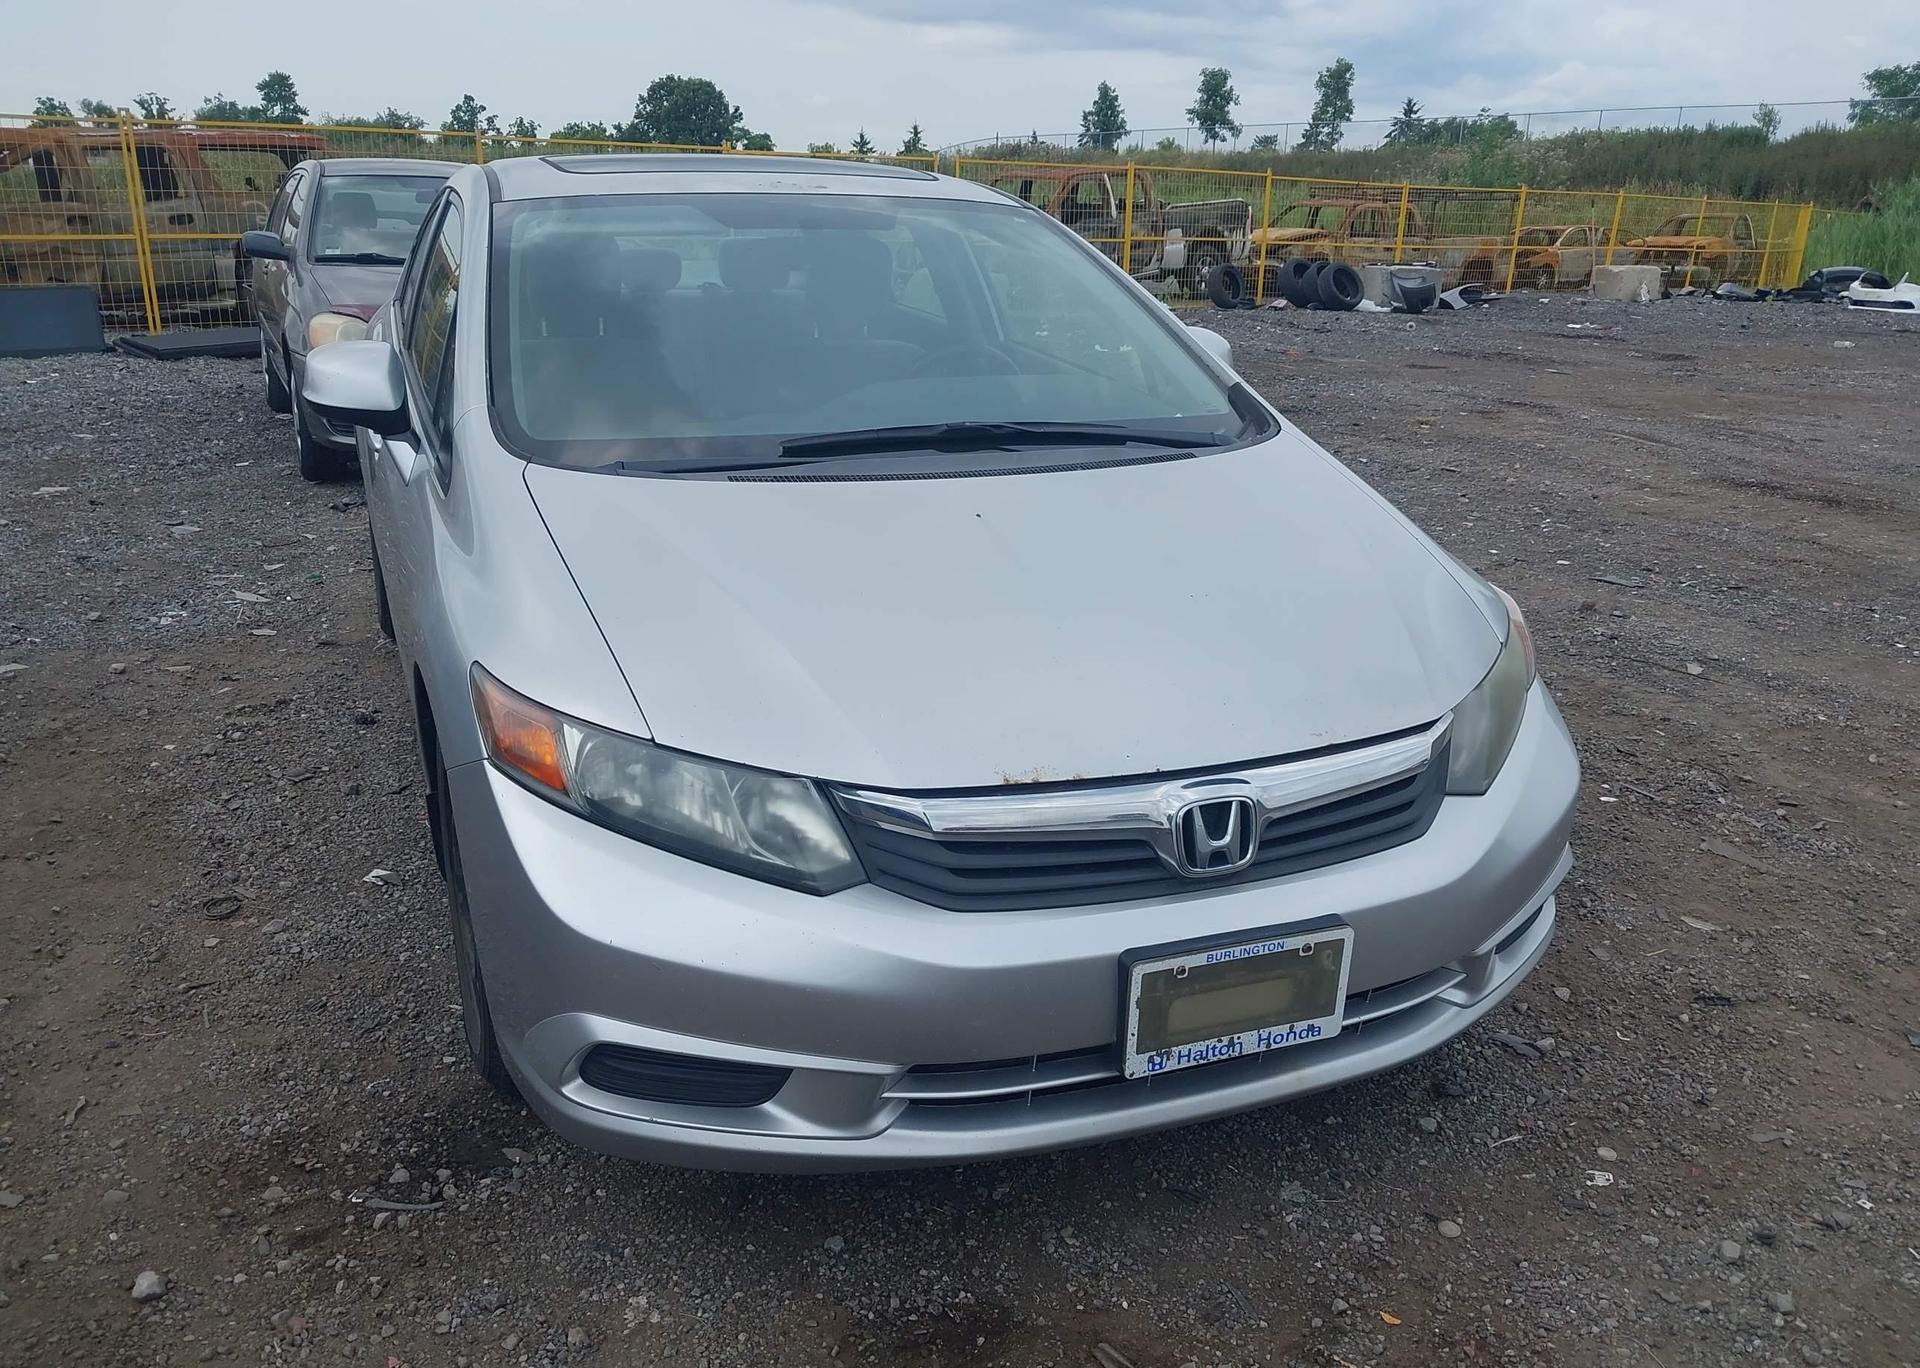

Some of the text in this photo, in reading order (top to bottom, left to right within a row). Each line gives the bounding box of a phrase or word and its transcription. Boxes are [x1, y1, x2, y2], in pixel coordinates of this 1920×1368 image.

[1206, 941, 1285, 963] BURLINGTON
[1177, 1040, 1243, 1065] Halton
[1257, 1024, 1322, 1049] Honda
